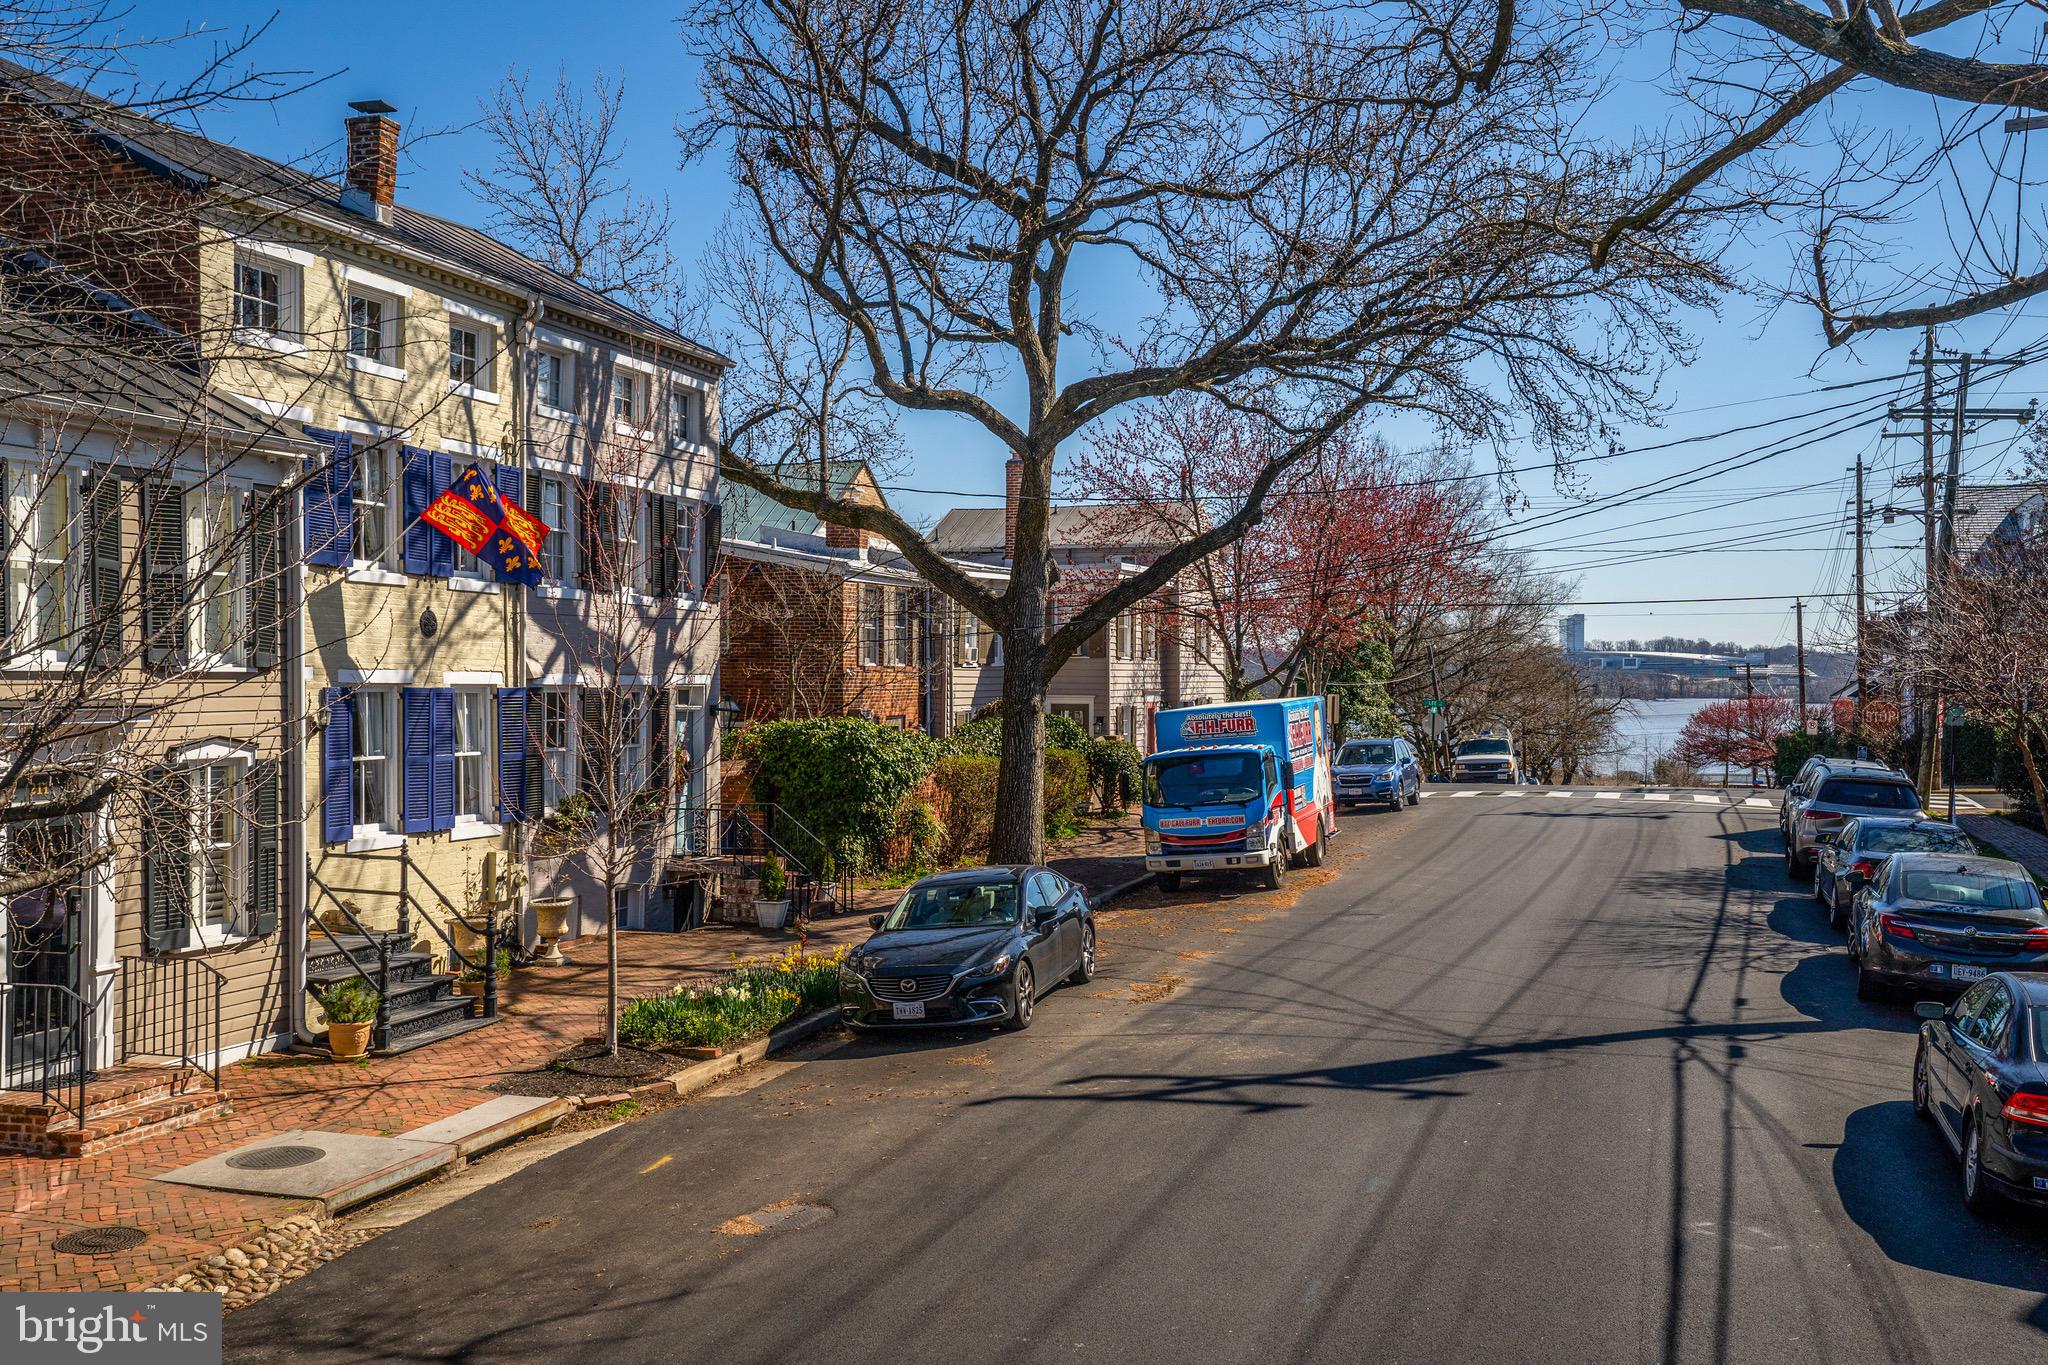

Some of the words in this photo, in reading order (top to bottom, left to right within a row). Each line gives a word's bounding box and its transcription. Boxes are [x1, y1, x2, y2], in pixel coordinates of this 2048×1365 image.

[1187, 711, 1222, 721] Absolutely
[1222, 711, 1234, 719] the
[1234, 709, 1252, 718] Best!
[1866, 710, 1897, 722] STOP
[1194, 717, 1255, 735] F.H.FURR
